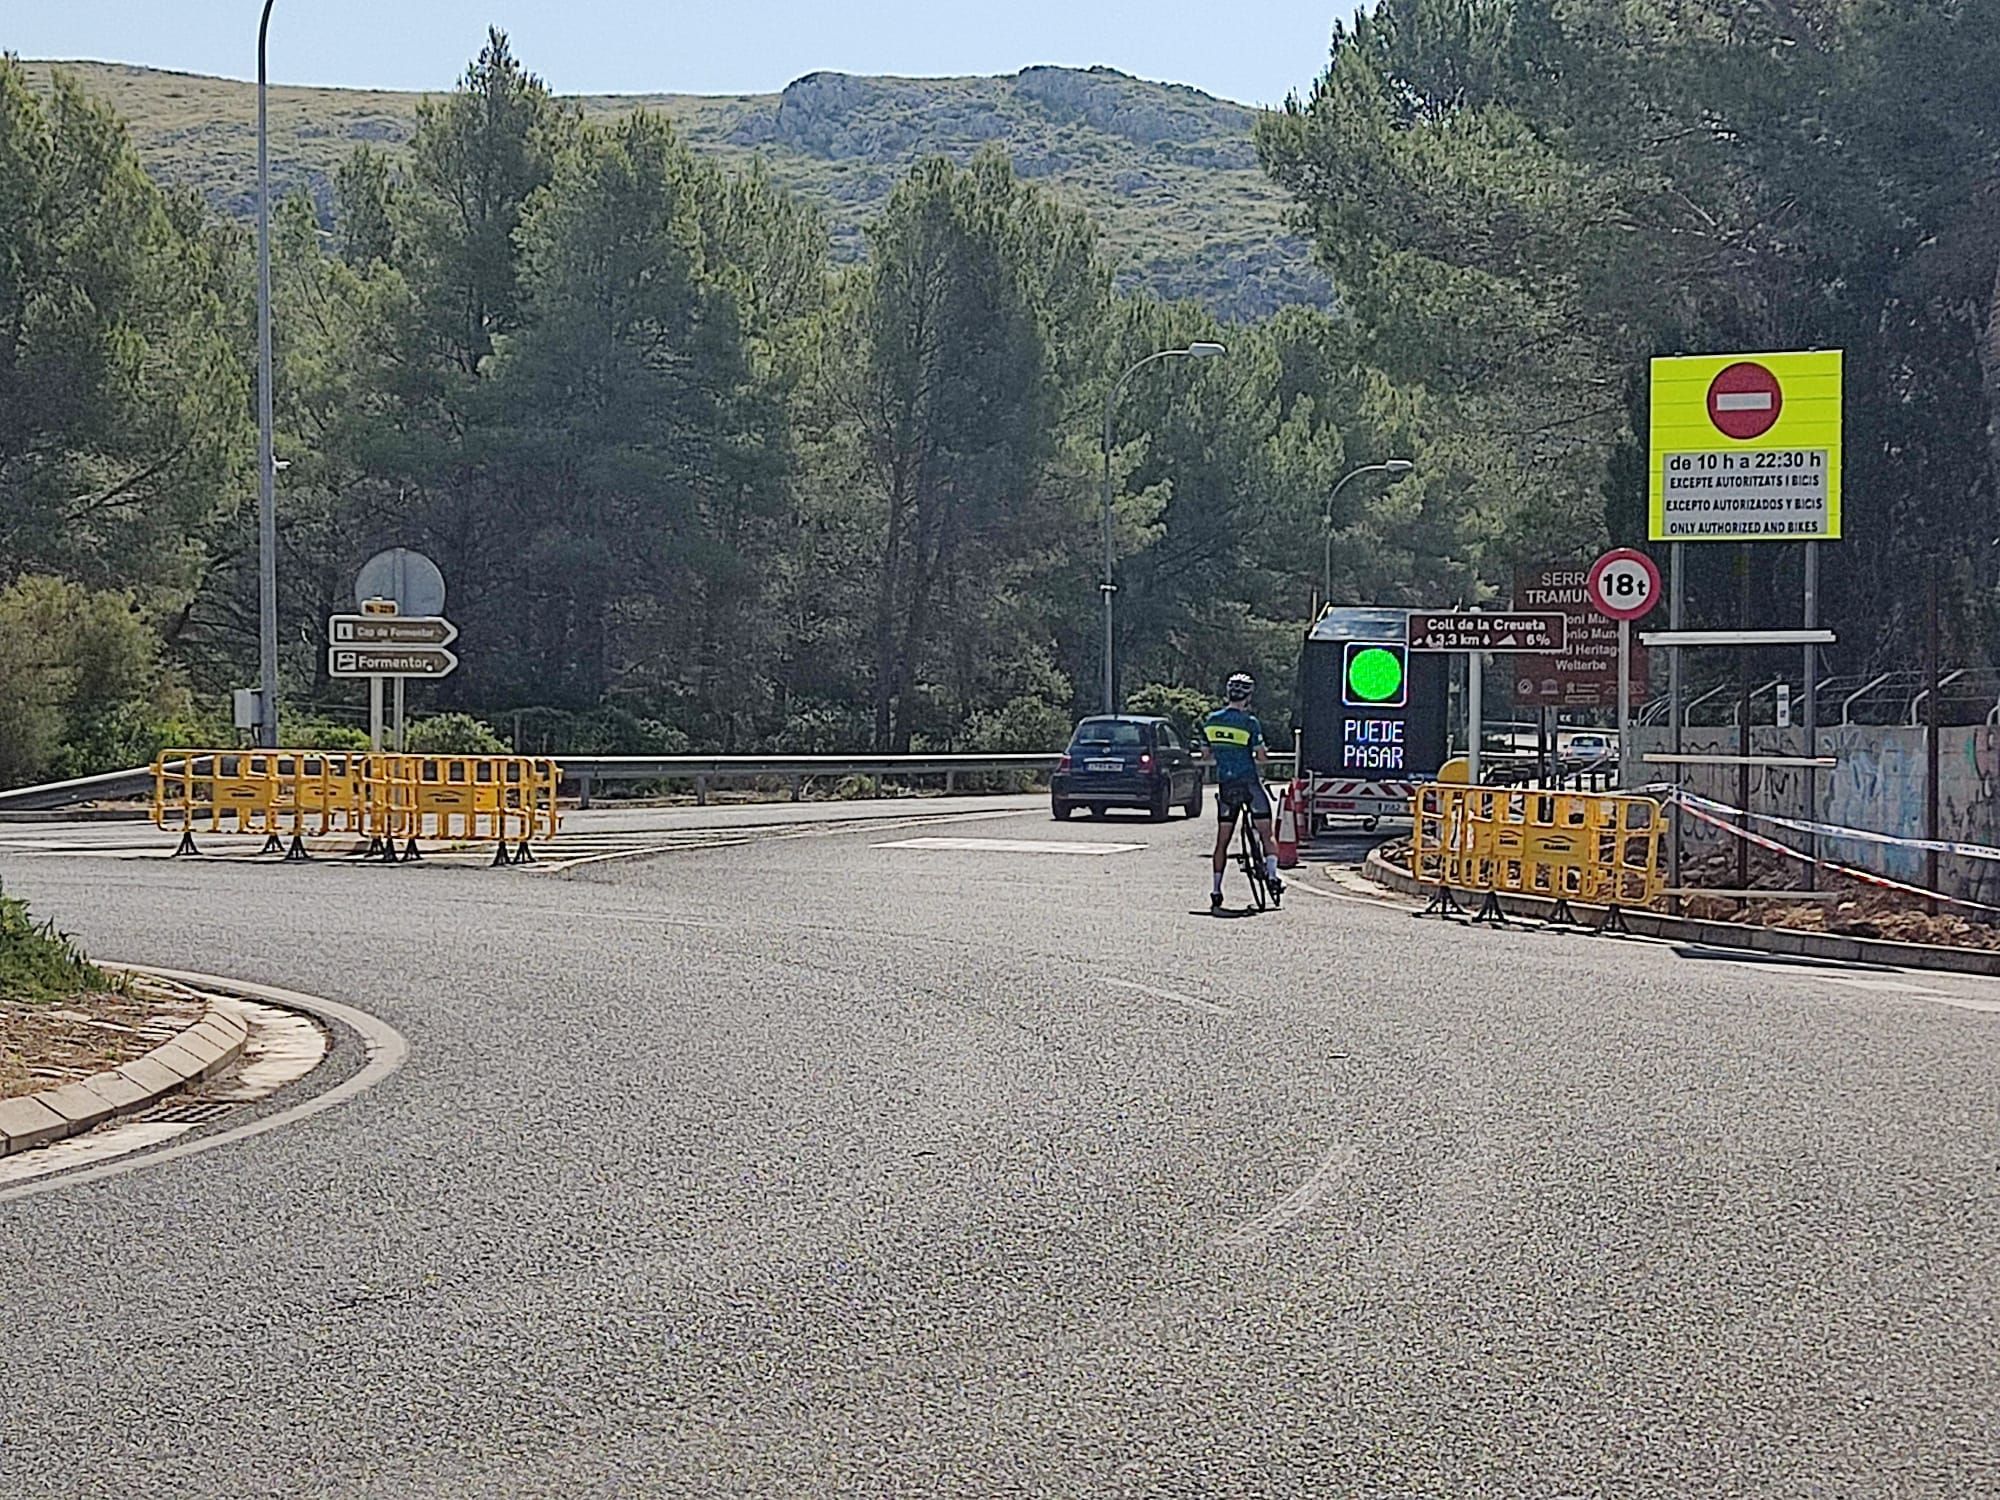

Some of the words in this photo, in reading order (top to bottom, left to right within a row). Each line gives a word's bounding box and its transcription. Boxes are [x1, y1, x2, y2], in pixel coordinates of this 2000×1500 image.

[1670, 455, 1691, 470] de
[1697, 454, 1717, 470] 10
[1723, 454, 1734, 469] h
[1739, 456, 1749, 469] a
[1755, 452, 1803, 469] 22:30
[1810, 452, 1821, 467] h
[1670, 477, 1713, 489] EXCEPTE
[1715, 475, 1783, 488] AUTORITZATS
[1791, 474, 1820, 486] BICIS
[1666, 500, 1711, 511] EXCEPTO
[1712, 499, 1784, 511] AUTORIZADOS
[1785, 499, 1793, 510] Y
[1795, 498, 1823, 510] BICIS
[1670, 523, 1696, 534] ONLY
[1697, 522, 1761, 534] AUTHORIZED
[1763, 522, 1785, 533] AND
[1787, 521, 1818, 533] BIKES
[1603, 573, 1634, 596] 18
[1637, 579, 1647, 597] t
[1526, 589, 1593, 604] TRAMUN
[1427, 618, 1455, 631] Coll
[1457, 618, 1474, 631] de
[1477, 619, 1490, 631] la
[1493, 619, 1546, 631] Creueta
[1460, 634, 1480, 645] km
[1526, 634, 1550, 646] 6%
[1575, 645, 1620, 657] Heritag
[358, 655, 429, 668] Formentor
[1555, 660, 1608, 671] Welterbe
[1344, 719, 1405, 743] PUEDE
[1343, 745, 1404, 769] PASAR
